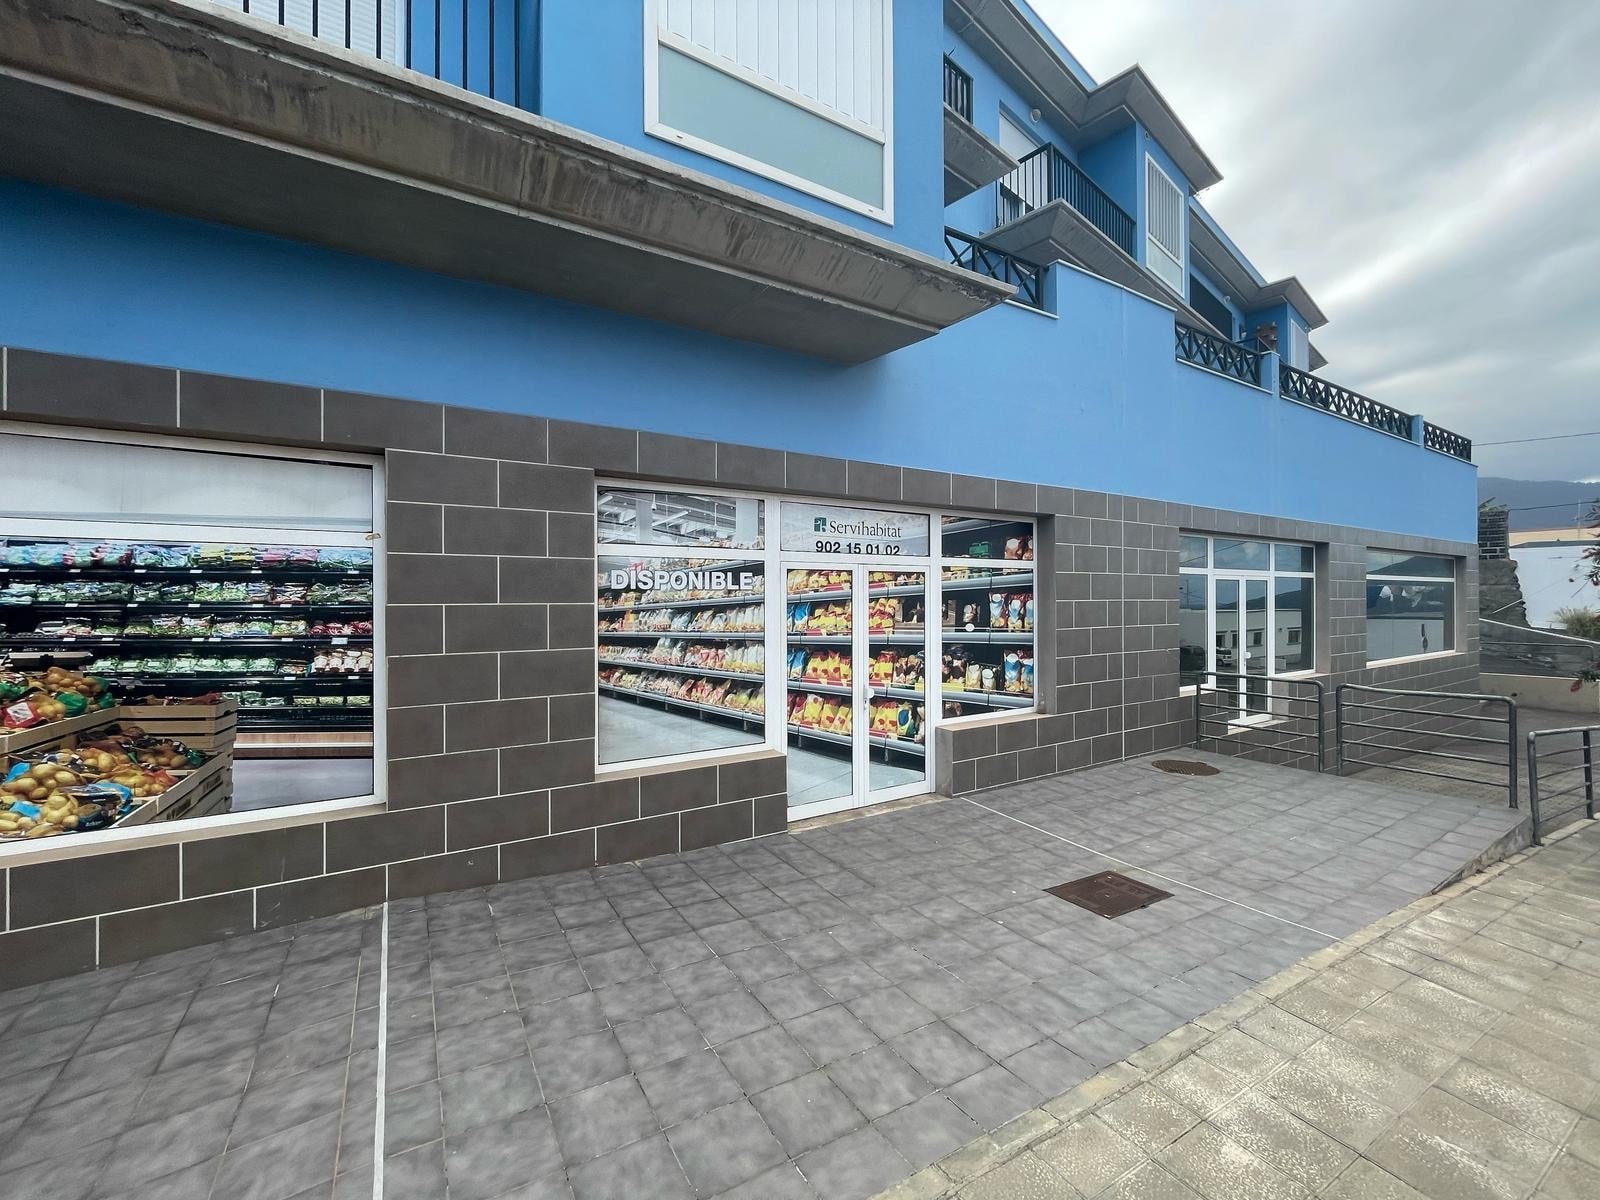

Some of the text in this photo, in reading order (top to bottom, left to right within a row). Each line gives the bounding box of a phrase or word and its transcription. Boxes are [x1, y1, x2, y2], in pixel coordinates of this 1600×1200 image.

[829, 520, 902, 538] Servihabitat
[815, 540, 900, 556] 902 15 01 02
[610, 569, 753, 590] DISPONIBLE
